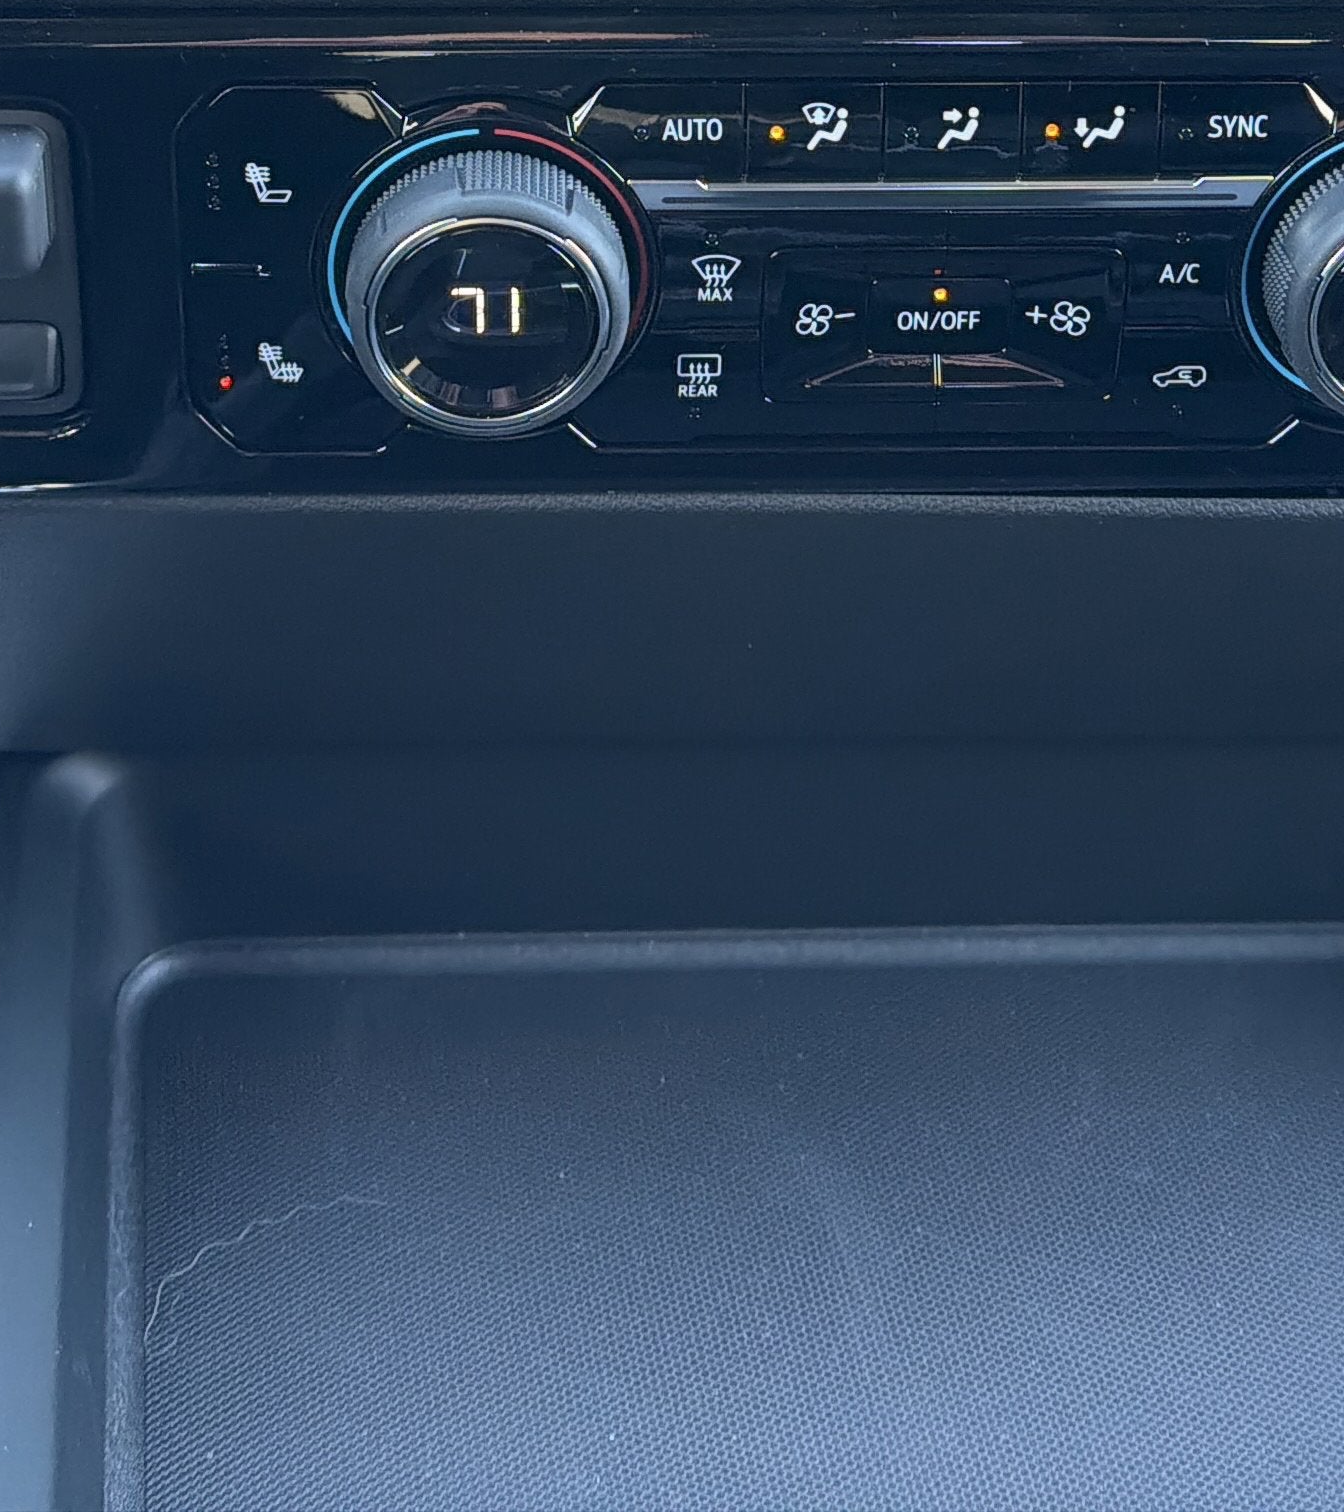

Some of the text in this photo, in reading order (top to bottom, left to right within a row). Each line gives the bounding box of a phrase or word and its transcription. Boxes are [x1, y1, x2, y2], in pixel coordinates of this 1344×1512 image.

[662, 118, 723, 141] AUTO
[1208, 114, 1269, 139] SYNC
[1159, 262, 1202, 285] A/C
[697, 287, 733, 302] MAX
[450, 286, 521, 335] 71
[896, 310, 981, 331] ON/OFF
[678, 383, 718, 399] REAR
